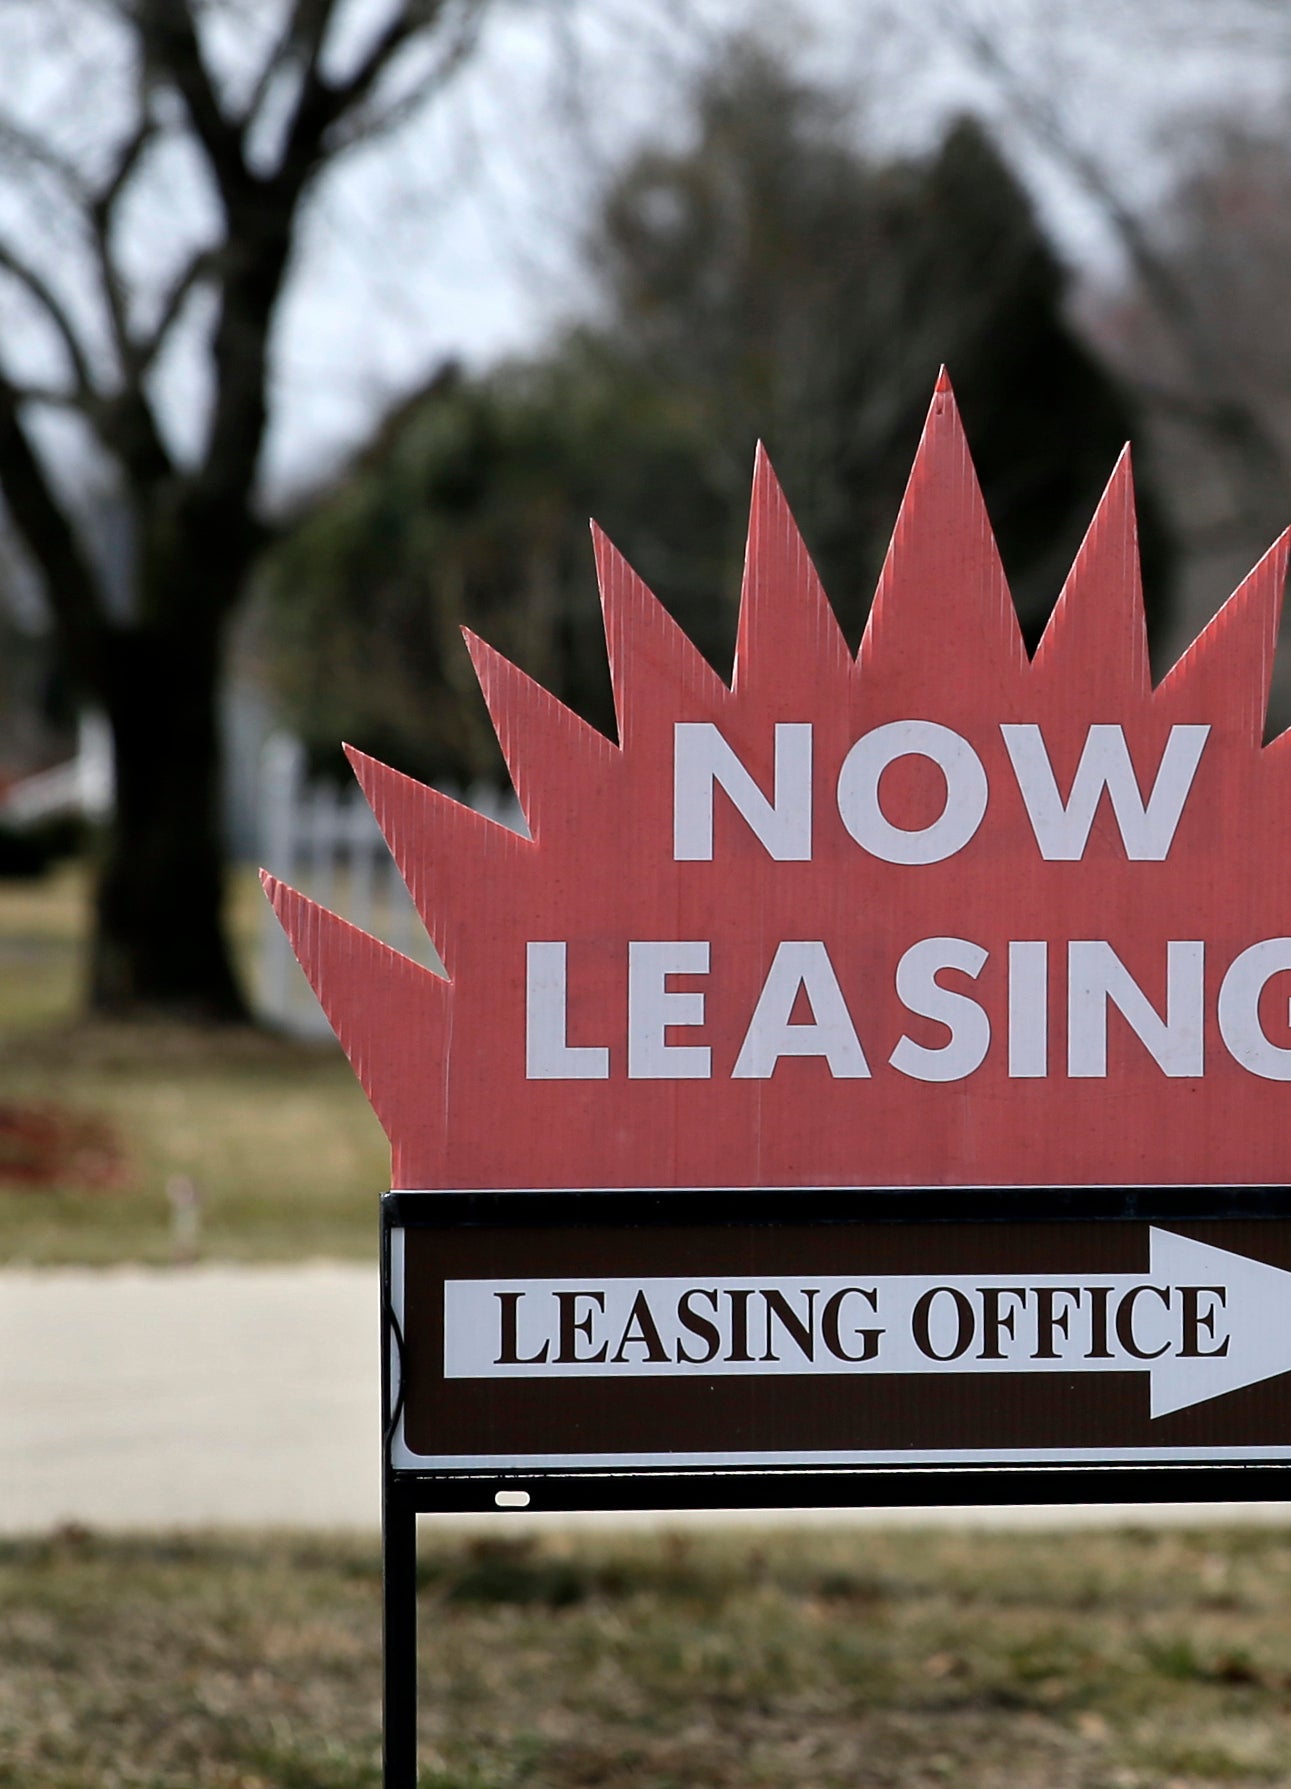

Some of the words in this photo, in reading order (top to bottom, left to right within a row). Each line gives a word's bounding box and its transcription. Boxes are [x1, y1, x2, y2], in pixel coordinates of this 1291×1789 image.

[673, 719, 1212, 866] NOW
[494, 1286, 886, 1365] LEASING
[911, 1286, 1231, 1363] OFFICE
